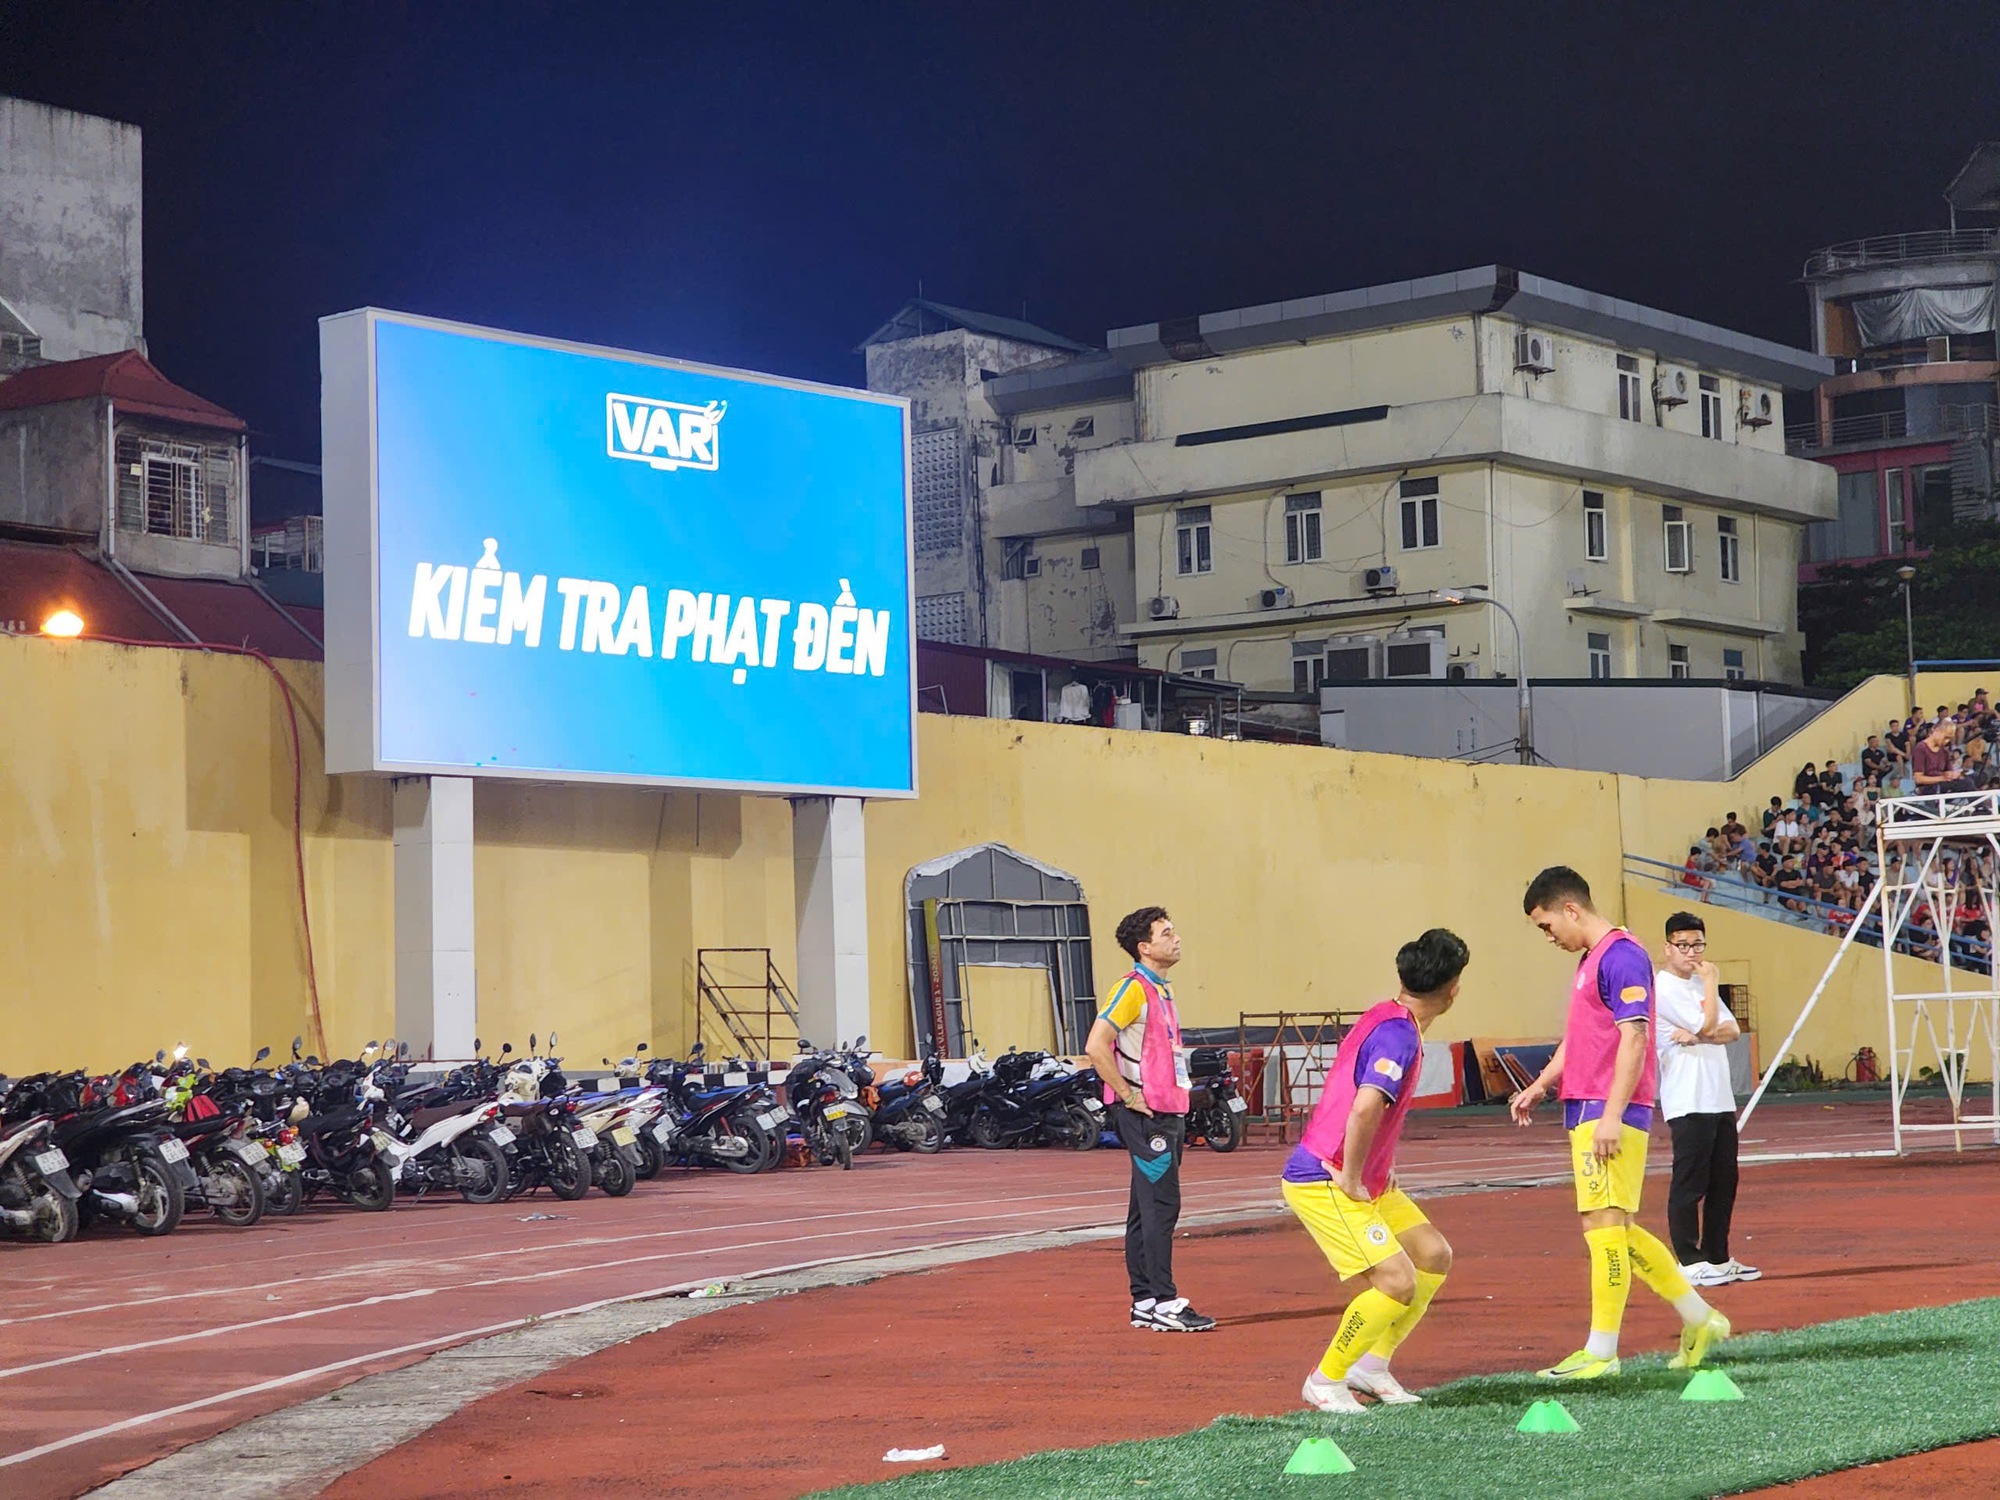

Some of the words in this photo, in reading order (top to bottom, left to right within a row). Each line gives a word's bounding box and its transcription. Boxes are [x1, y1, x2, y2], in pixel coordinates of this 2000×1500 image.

[612, 402, 713, 461] VAR
[408, 538, 547, 647] KIỂM
[557, 577, 653, 657] TRA
[661, 588, 790, 684] PHẠT
[793, 578, 890, 676] ĐỀN
[935, 996, 946, 1043] V.LEAGUE
[1605, 1247, 1621, 1287] JOGARBOLA
